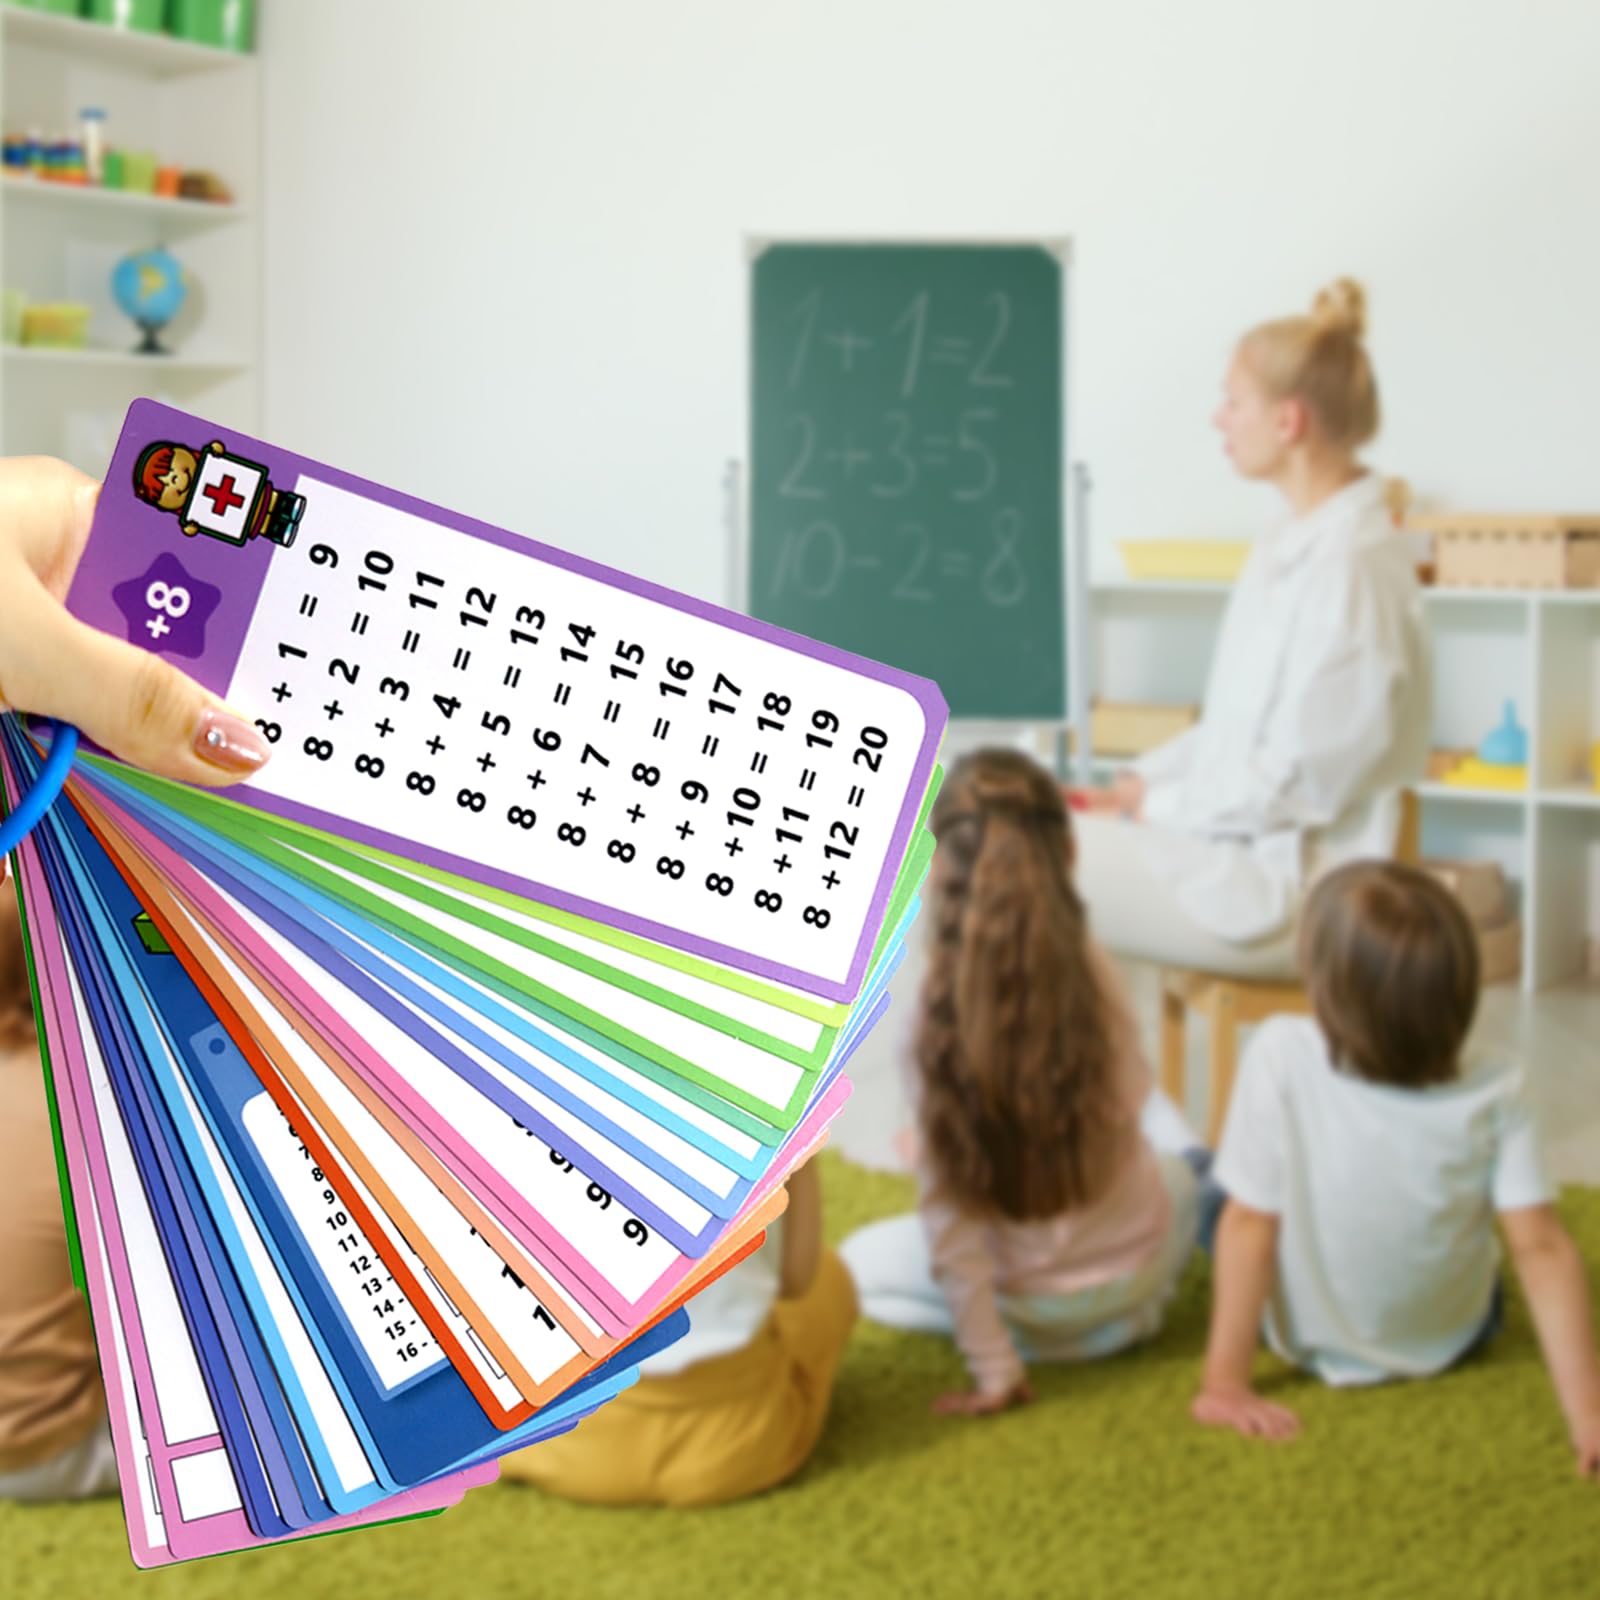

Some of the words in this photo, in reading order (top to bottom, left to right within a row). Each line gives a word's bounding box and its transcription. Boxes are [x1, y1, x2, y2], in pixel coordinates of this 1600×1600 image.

[309, 543, 339, 569] 9
[357, 550, 394, 592] 10
[408, 571, 445, 610] 11
[145, 580, 192, 640] +8
[299, 594, 318, 617] =
[459, 587, 497, 627] 12
[350, 612, 370, 635] =
[509, 605, 546, 645] 13
[278, 642, 308, 659] 1
[401, 629, 421, 653] =
[560, 622, 597, 663] 14
[452, 647, 471, 671] =
[609, 639, 645, 680] 15
[328, 658, 361, 685] 2
[503, 665, 522, 689] =
[659, 657, 695, 697] 16
[271, 682, 293, 703] +
[379, 676, 410, 702] 3
[553, 682, 572, 706] =
[708, 672, 742, 715] 17
[323, 700, 344, 721] +
[432, 694, 462, 719] 4
[603, 700, 621, 723] =
[757, 691, 792, 732] 18
[374, 717, 395, 738] +
[480, 711, 511, 736] 5
[652, 717, 671, 740] =
[805, 709, 840, 748] 19
[303, 736, 334, 762] 8
[425, 735, 446, 756] +
[532, 727, 562, 752] 6
[701, 734, 720, 757] =
[852, 726, 888, 773] 20
[354, 753, 385, 779] 8
[476, 752, 497, 773] +
[580, 743, 610, 768] 7
[750, 751, 768, 774] =
[405, 771, 436, 796] 8
[526, 769, 547, 790] +
[631, 762, 661, 787] 8
[799, 768, 817, 791] =
[456, 788, 487, 813] 8
[576, 786, 597, 807] +
[680, 780, 709, 804] 9
[847, 785, 865, 808] =
[507, 805, 537, 830] 8
[626, 803, 646, 824] +
[557, 822, 587, 847] 8
[675, 820, 695, 841] +
[606, 839, 636, 864] 8
[656, 856, 685, 880] 8
[705, 872, 734, 897] 8
[754, 889, 783, 913] 8
[802, 905, 831, 929] 8
[311, 1167, 324, 1182] 8
[323, 1189, 335, 1205] 9
[586, 1181, 612, 1210] 9
[326, 1211, 348, 1231] 10
[622, 1218, 649, 1247] 9
[338, 1233, 359, 1253] 11
[349, 1255, 373, 1275] 12
[361, 1277, 383, 1297] 13
[372, 1298, 395, 1319] 14
[384, 1320, 406, 1341] 15
[396, 1342, 419, 1363] 16
